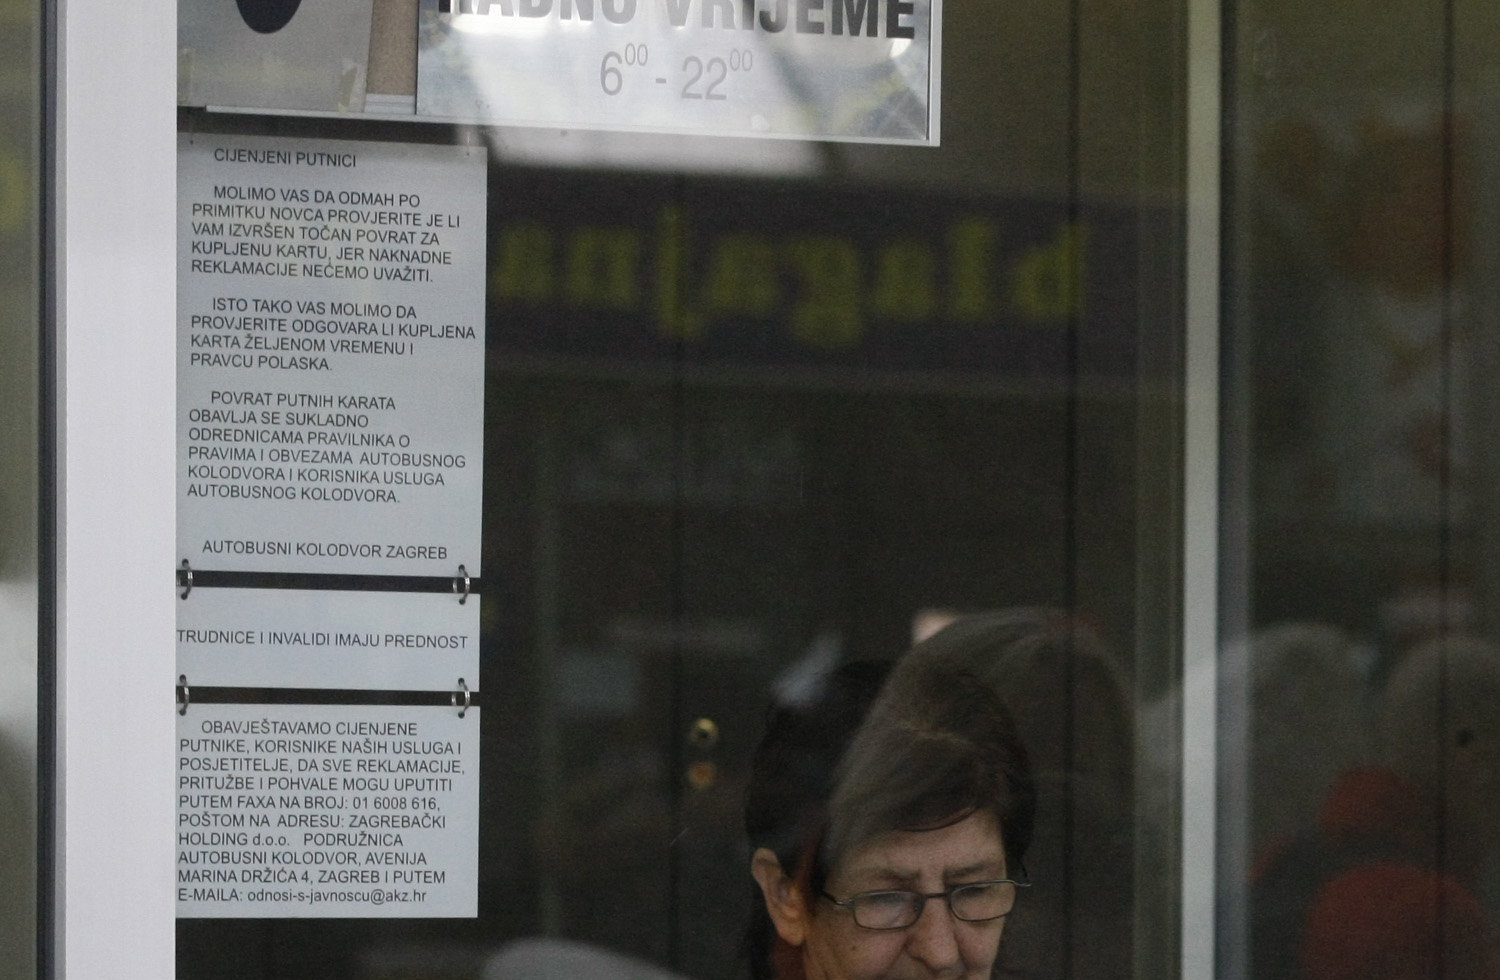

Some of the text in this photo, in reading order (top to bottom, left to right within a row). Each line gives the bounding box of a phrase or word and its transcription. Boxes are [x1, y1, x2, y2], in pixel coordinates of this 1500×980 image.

[213, 148, 356, 168] CIJENJENI PUTNICI
[213, 185, 420, 208] MOLIMO VAS DA ODMAH PO
[192, 203, 459, 228] PRIMITKU NOVCA PROVJERITE JE LI
[191, 220, 439, 246] VAM IZVRŠEN TOČAN POVRAT ZA
[191, 240, 451, 266] KUPLJENU KARTU, JER NAKNADNE
[191, 259, 432, 283] REKLAMACIJE NEĆEMO UVAŽITI.
[212, 297, 416, 319] ISTO TAKO VAS MOLIMO DA
[191, 315, 475, 340] PROVJERITE ODGOVARA LI KUPLJENA
[190, 334, 241, 350] KARTA
[243, 333, 325, 353] ŽELJENOM
[329, 339, 404, 355] VREMENU
[190, 352, 332, 371] PRAVCU POLASKA.
[210, 391, 396, 410] POVRAT PUTNIH KARATA
[188, 410, 368, 428] OBAVLJA SE SUKLADNO
[188, 428, 304, 445] ODREDNICAMA
[307, 431, 395, 448] PRAVILNIKA
[188, 446, 256, 462] PRAVIMA
[268, 449, 353, 465] OBVEZAMA
[359, 451, 465, 468] AUTOBUSNOG
[188, 464, 285, 481] KOLODVORA
[297, 468, 380, 484] KORISNIKA
[383, 470, 444, 486] USLUGA
[186, 483, 399, 503] AUTOBUSNOG KOLODVORA.
[202, 540, 447, 560] AUTOBUSNI KOLODVOR ZAGREB
[176, 630, 254, 645] TRUDNICE
[268, 631, 329, 647] INVALIDI
[334, 633, 379, 648] IMAJU
[384, 634, 468, 649] PREDNOST
[201, 718, 417, 736] OBAVJEŠTAVAMO CIJENJENE
[179, 739, 249, 756] PUTNIKE,
[254, 739, 337, 754] KORISNIKE
[341, 737, 387, 754] NAŠIH
[392, 740, 454, 755] USLUGA
[179, 758, 464, 776] POSJETITELJE, DA SVE REKLAMACIJE,
[179, 773, 254, 791] PRITUŽBE
[267, 777, 338, 791] POHVALE
[342, 777, 389, 792] MOGU
[394, 778, 451, 792] UPUTITI
[178, 795, 440, 813] PUTEM FAXA NA BROJ: 01 6008 616,
[178, 811, 445, 829] POŠTOM NA ADRESU: ZAGREBAČKI
[178, 830, 403, 847] HOLDING d.o.o. PODRUŽNICA
[177, 851, 427, 868] AUTOBUSNI KOLODVOR, AVENIJA
[178, 870, 237, 884] MARINA
[241, 867, 298, 884] DRŽIĆA
[300, 870, 313, 886] 4,
[317, 870, 380, 884] ZAGREB
[393, 871, 445, 885] PUTEM
[178, 888, 242, 902] E-MAILA:
